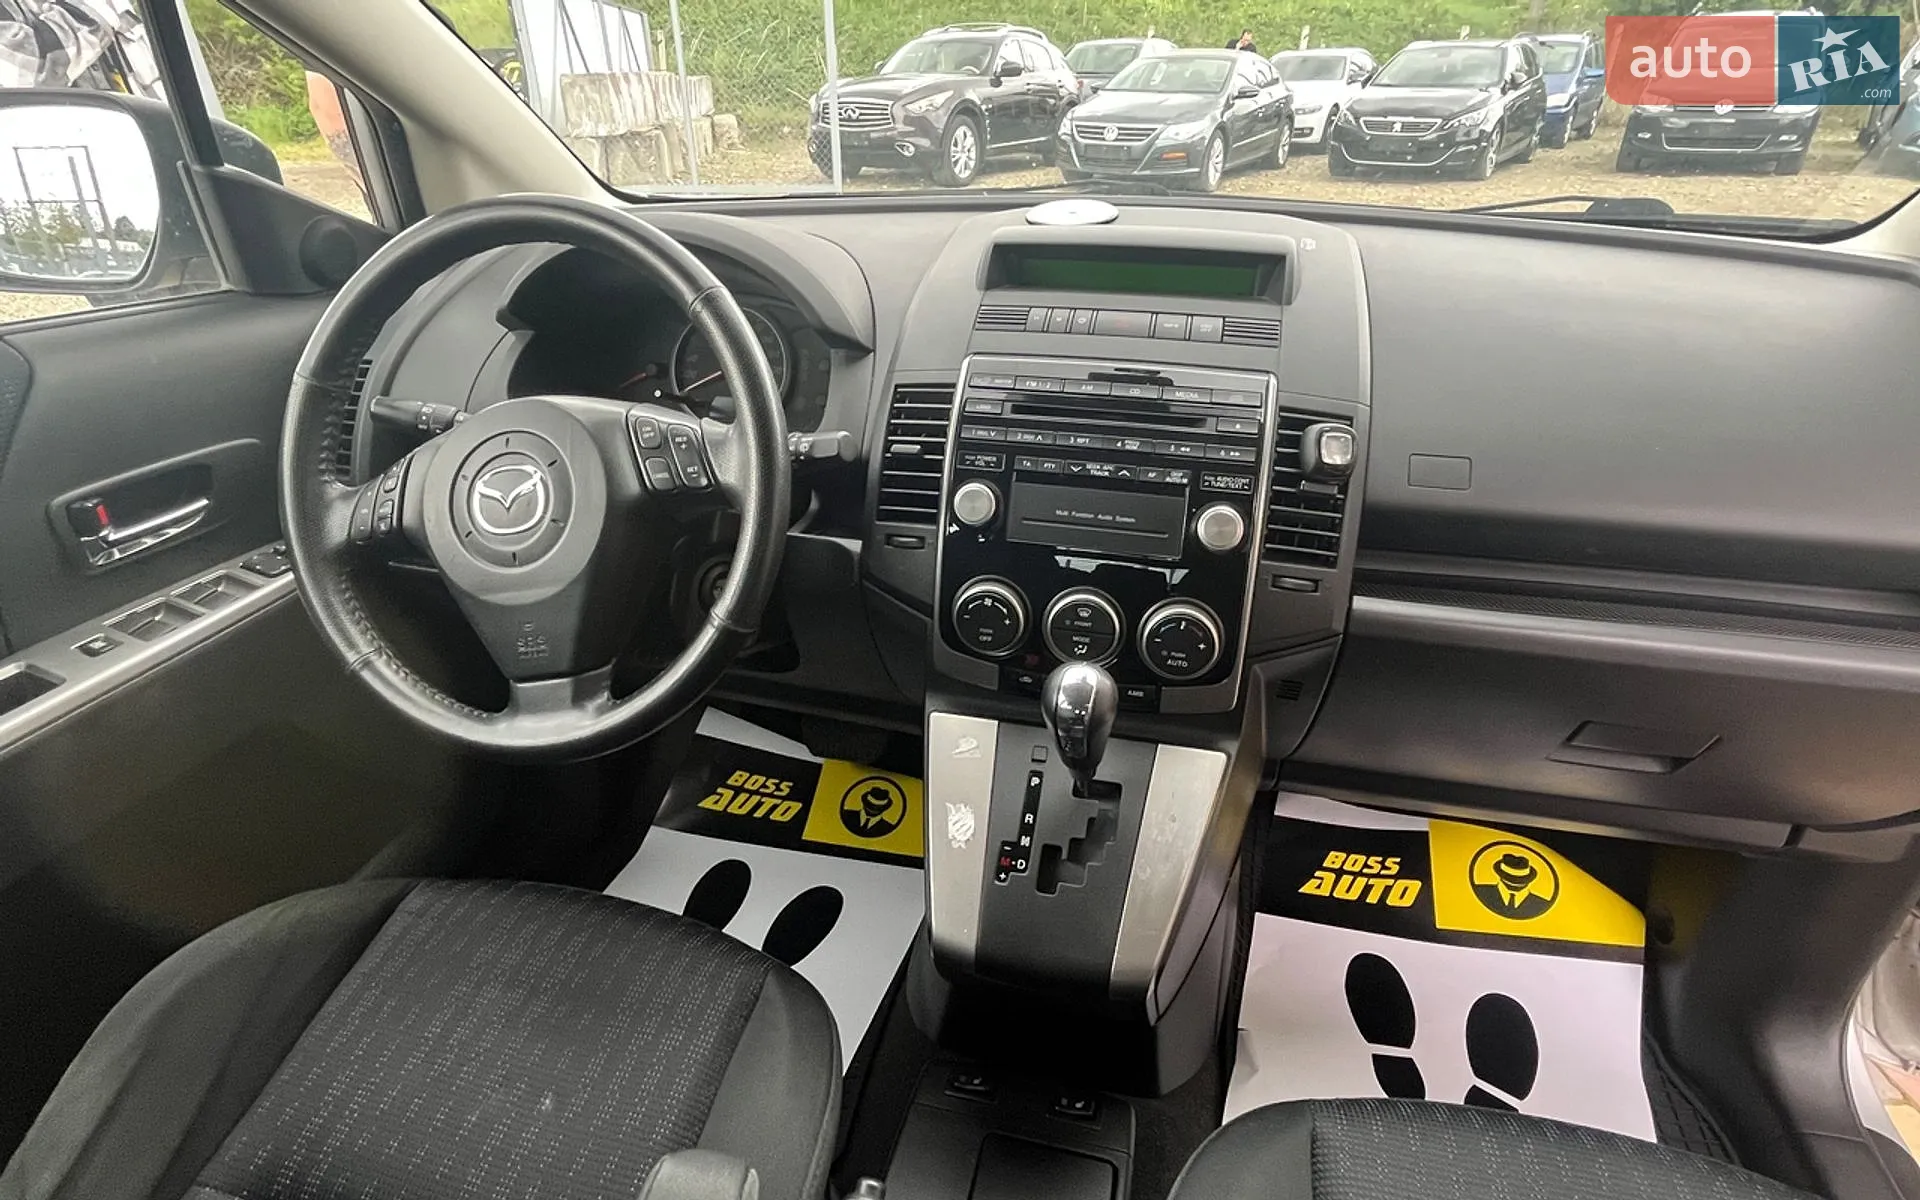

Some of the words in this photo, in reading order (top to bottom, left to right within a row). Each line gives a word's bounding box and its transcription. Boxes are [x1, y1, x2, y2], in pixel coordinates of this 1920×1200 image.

[1175, 390, 1200, 399] MEDIA
[1090, 469, 1110, 477] TRACK
[1166, 658, 1188, 669] AUTO
[726, 769, 794, 797] BOSS
[1030, 776, 1041, 787] P
[697, 786, 803, 823] AUTO
[1024, 813, 1034, 825] R
[1020, 835, 1031, 848] N
[1016, 859, 1026, 870] D
[1322, 850, 1402, 876] BOSS
[1298, 870, 1423, 908] AUTO
